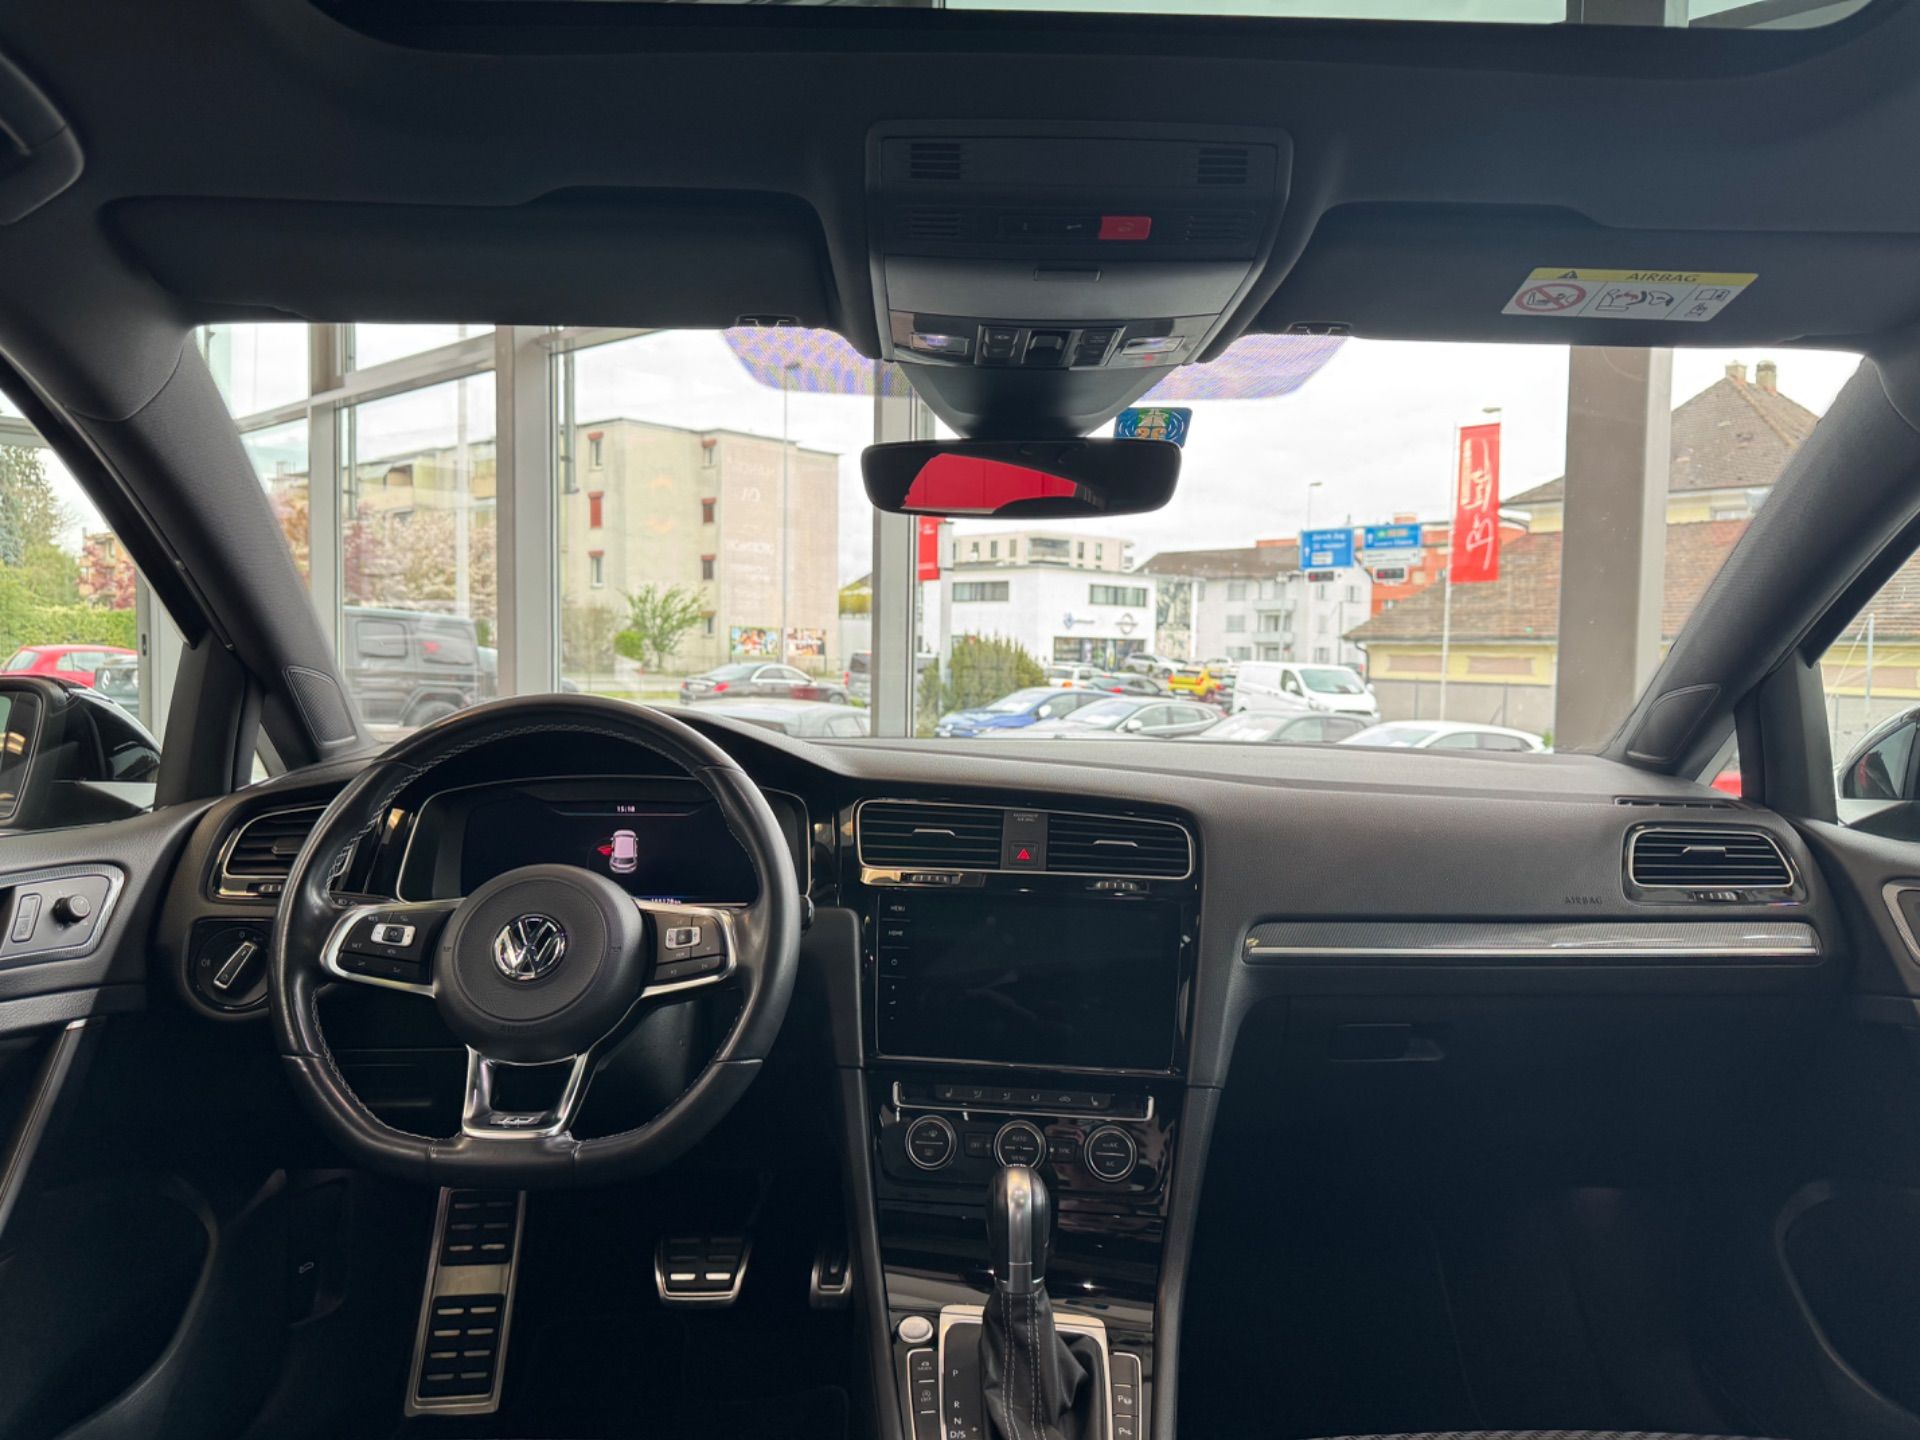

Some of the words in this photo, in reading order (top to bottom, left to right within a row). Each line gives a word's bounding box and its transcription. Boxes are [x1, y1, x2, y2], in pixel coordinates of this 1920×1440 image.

[1625, 271, 1699, 283] AIRBAG
[1564, 895, 1603, 905] AIRBAG
[952, 1369, 959, 1377] P
[953, 1401, 961, 1409] R
[954, 1417, 962, 1425] N
[950, 1430, 967, 1440] D/S
